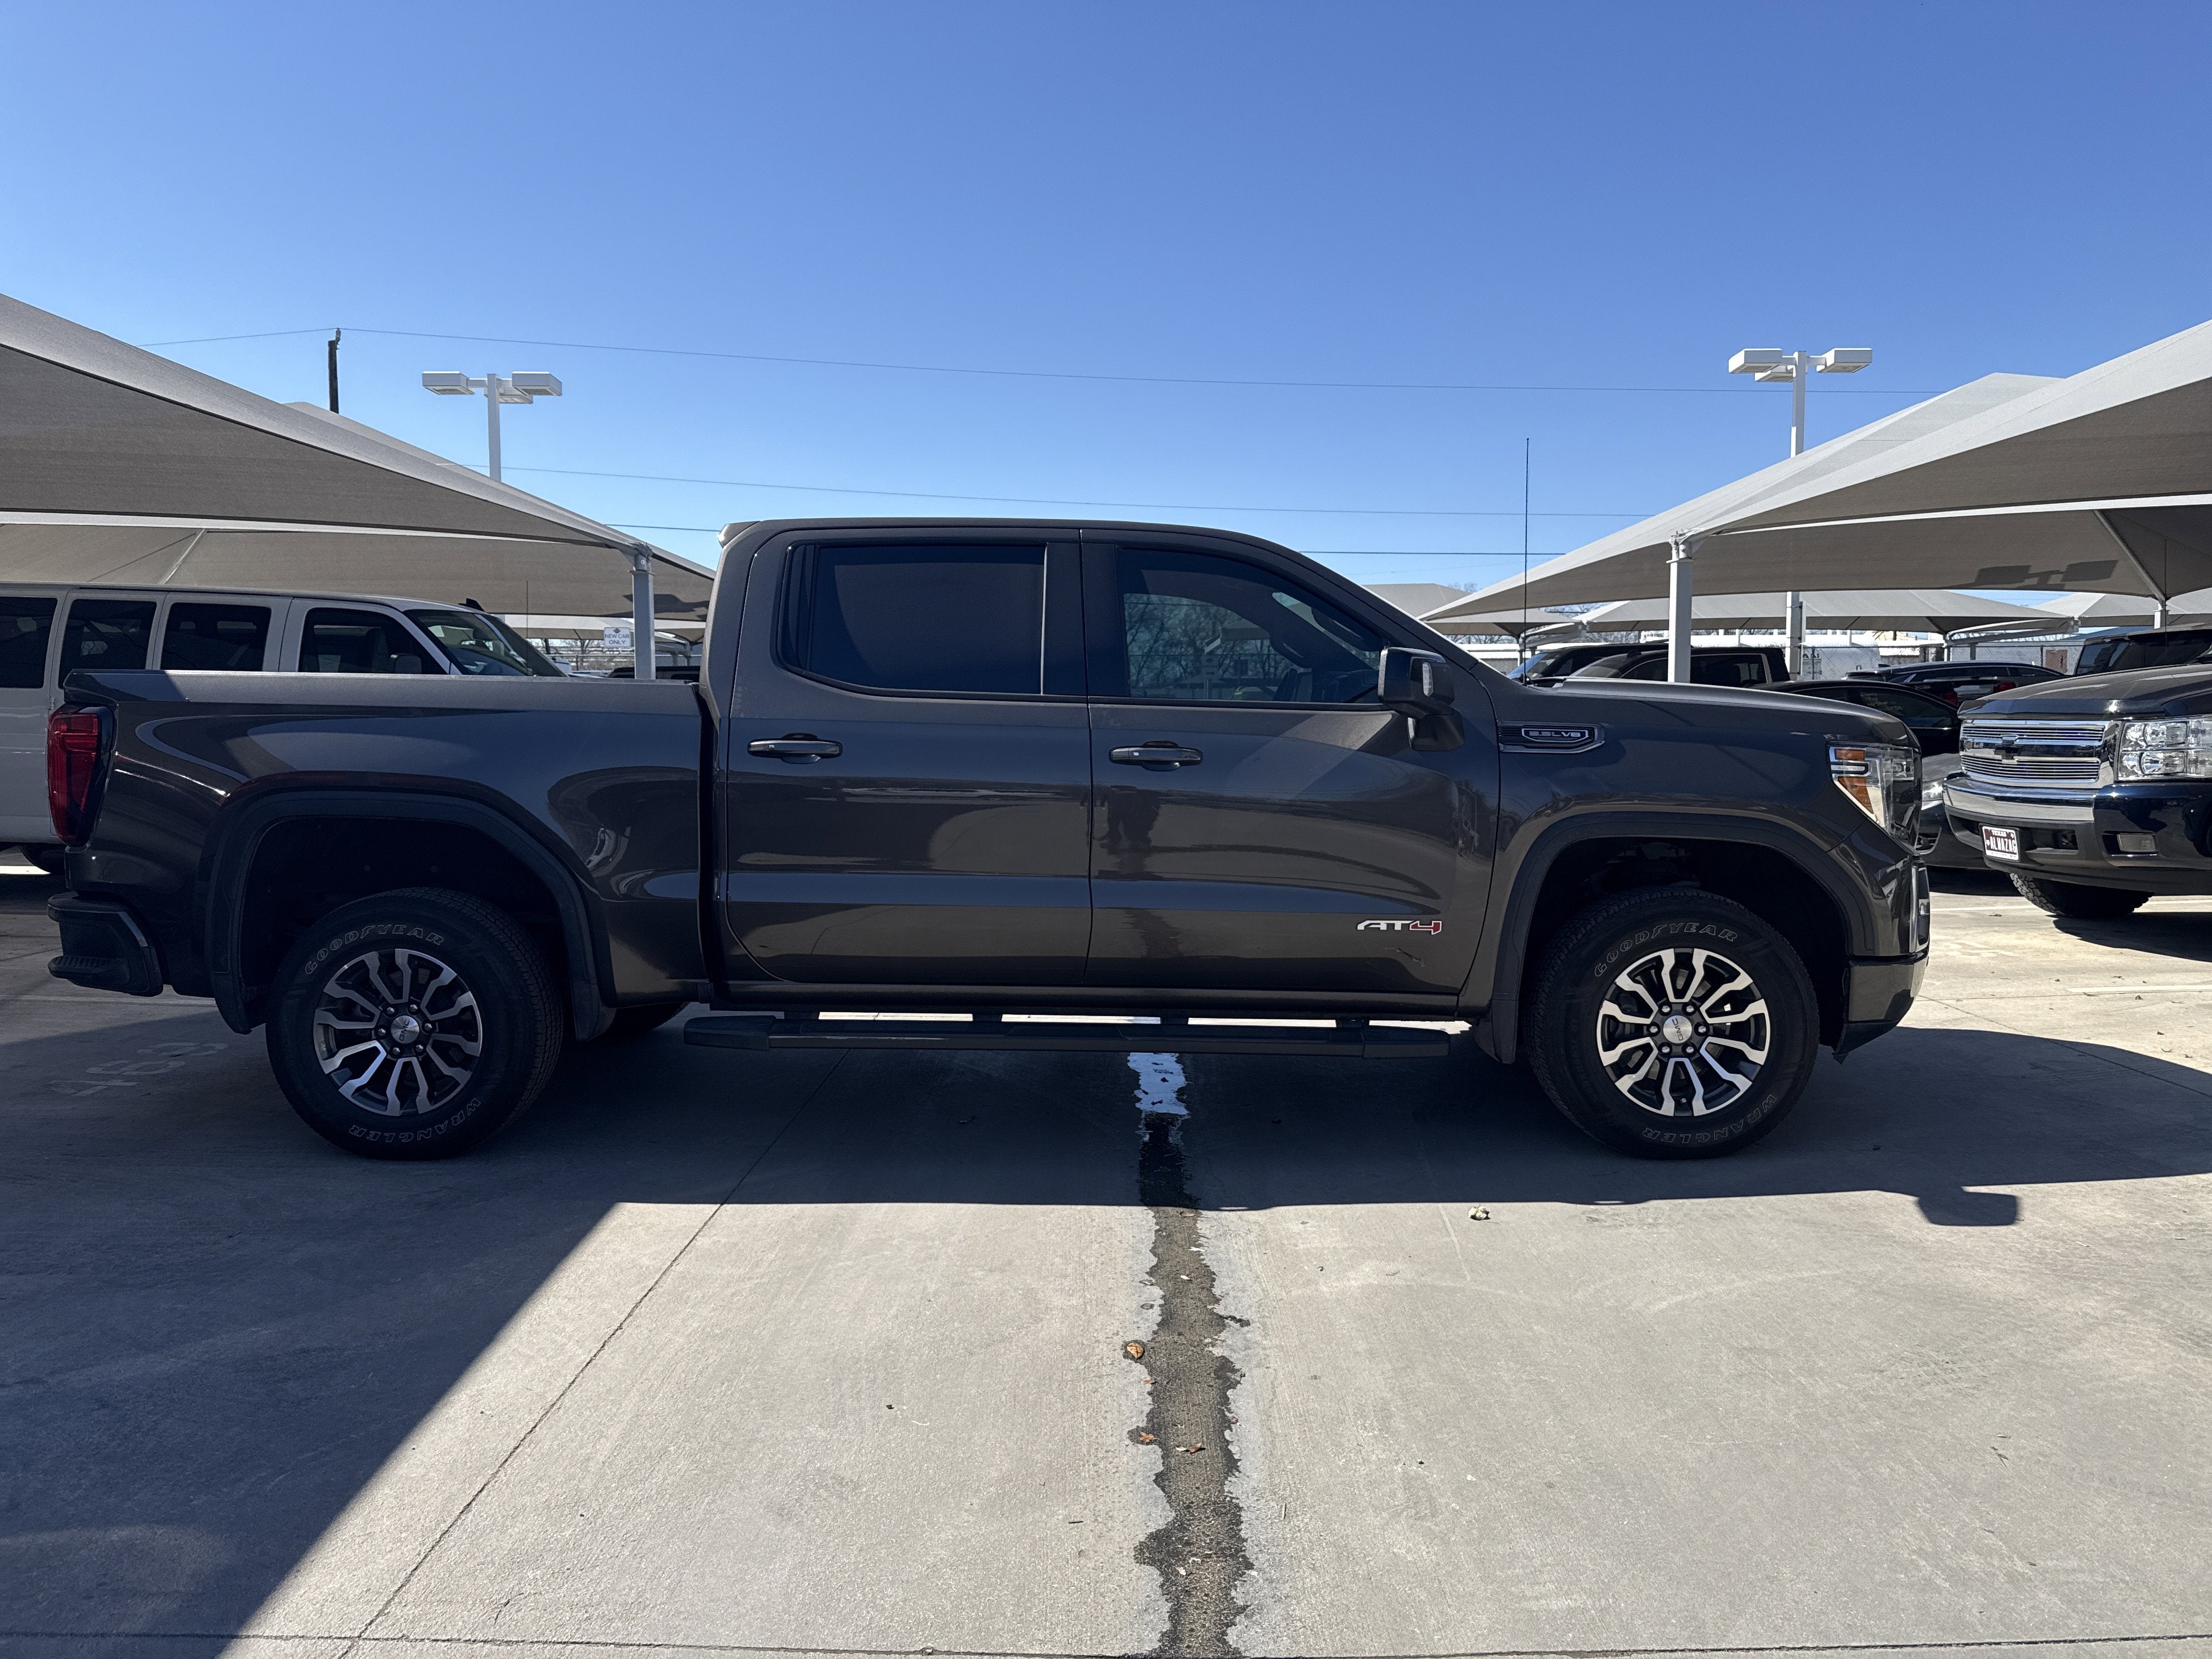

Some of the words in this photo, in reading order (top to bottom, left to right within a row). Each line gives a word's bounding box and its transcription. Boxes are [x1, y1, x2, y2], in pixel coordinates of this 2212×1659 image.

[305, 924, 444, 974] GOODYEAR
[1357, 920, 1442, 935] AT4
[1594, 922, 1737, 977] GOODYEAR
[399, 1018, 410, 1041] GMC
[1672, 1018, 1684, 1041] GMC
[348, 1098, 481, 1143] WRANGLER
[1642, 1094, 1778, 1144] WRANGLER
